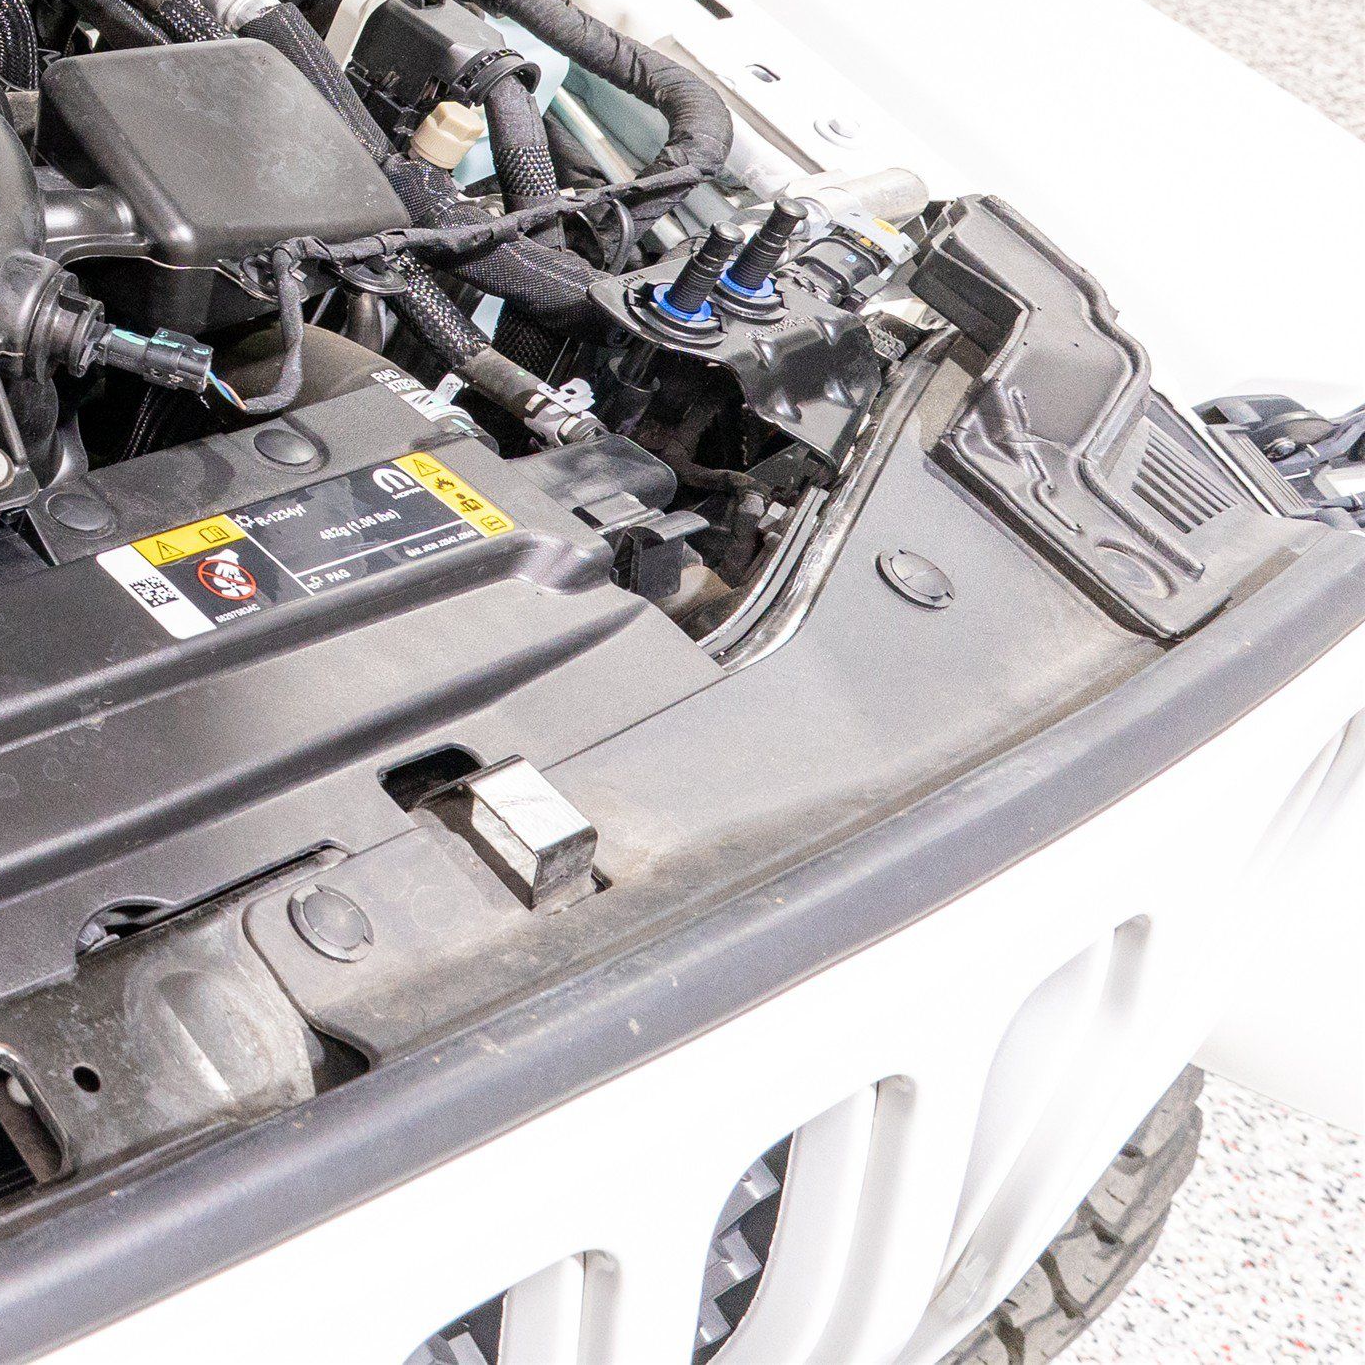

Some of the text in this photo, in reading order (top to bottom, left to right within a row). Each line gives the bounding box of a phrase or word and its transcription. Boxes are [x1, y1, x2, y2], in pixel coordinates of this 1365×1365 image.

[254, 502, 308, 528] R-1234yf
[373, 508, 402, 523] lbs)
[325, 568, 352, 583] PAG
